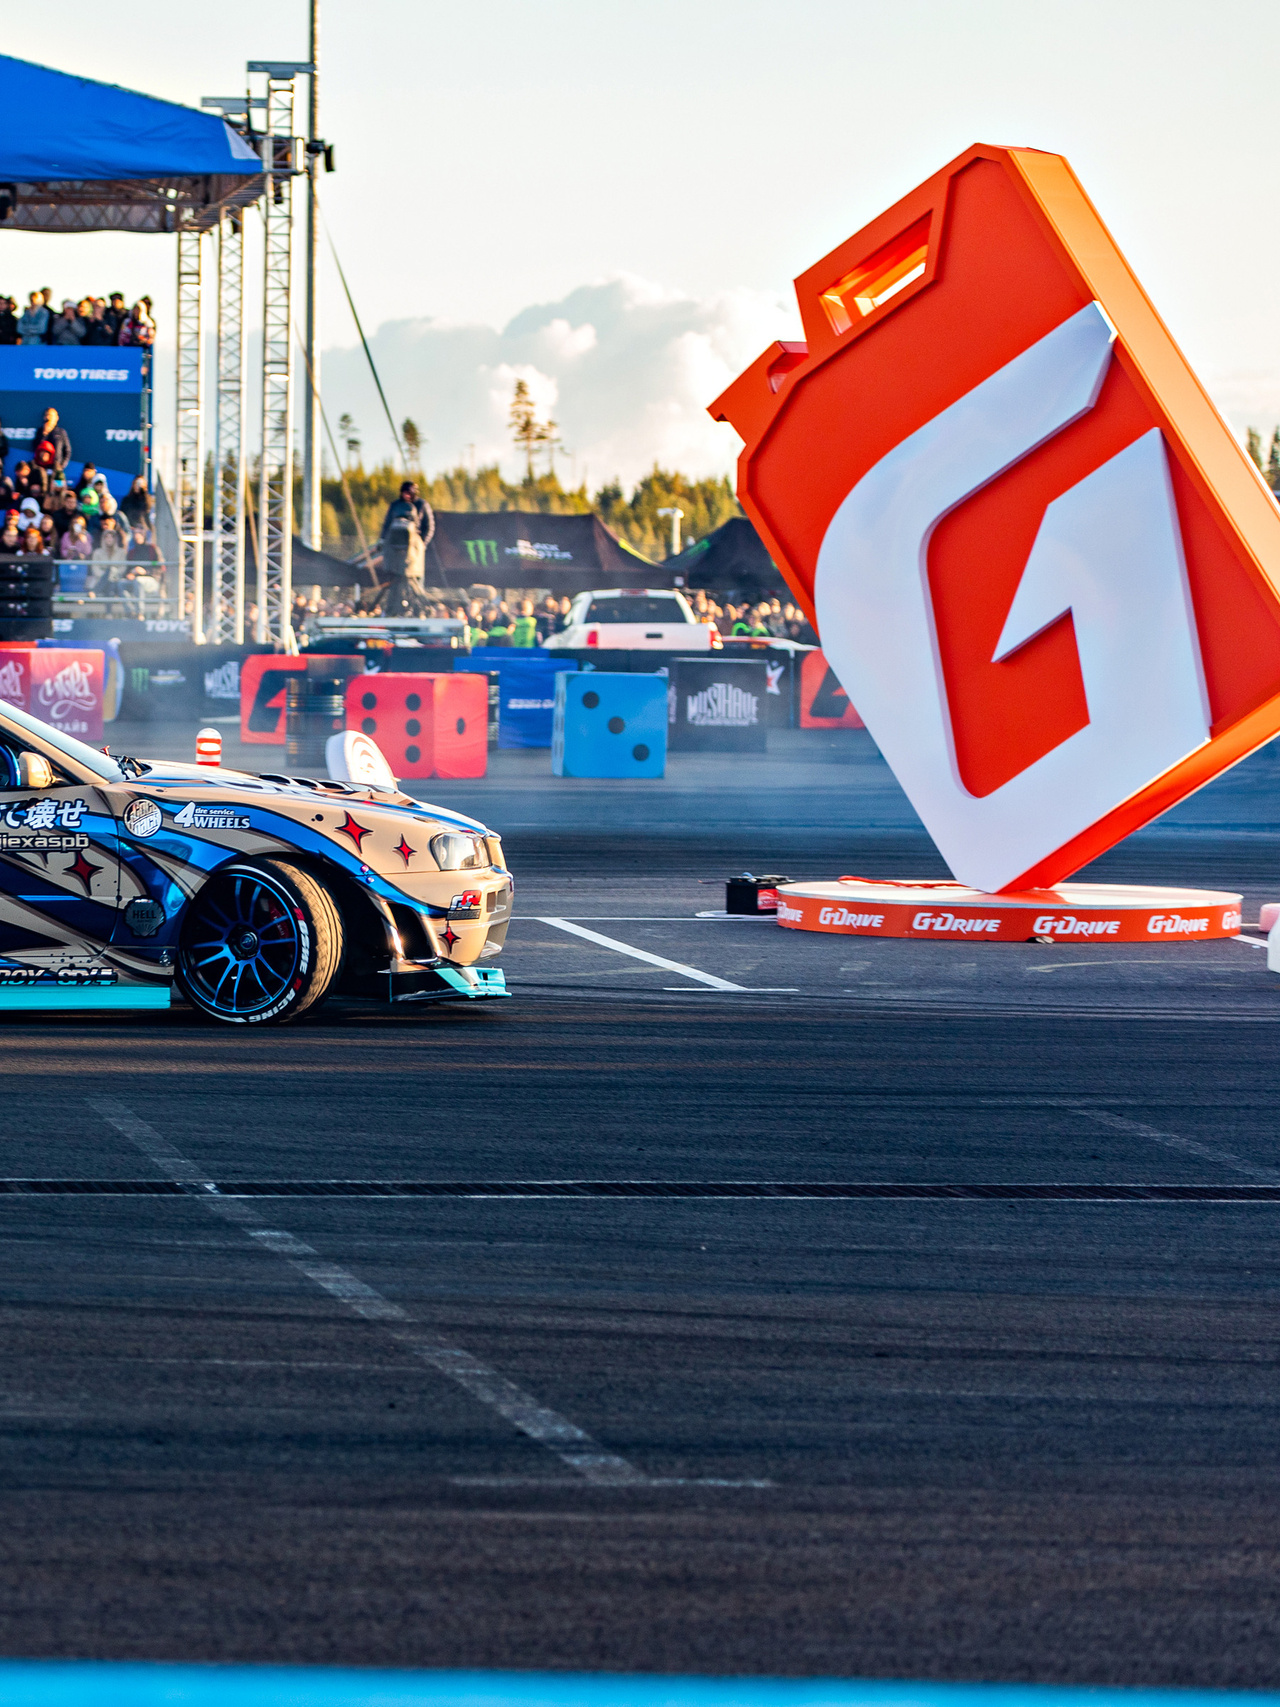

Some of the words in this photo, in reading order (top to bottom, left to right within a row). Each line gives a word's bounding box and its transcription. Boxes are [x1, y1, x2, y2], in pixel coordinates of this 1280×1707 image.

[34, 368, 80, 380] TOYO
[80, 369, 130, 381] TIRES
[2, 427, 36, 439] RES
[173, 801, 196, 828] 4
[195, 807, 208, 815] tire
[209, 808, 234, 816] service
[194, 816, 250, 829] WHEELS
[248, 977, 302, 1022] RACING
